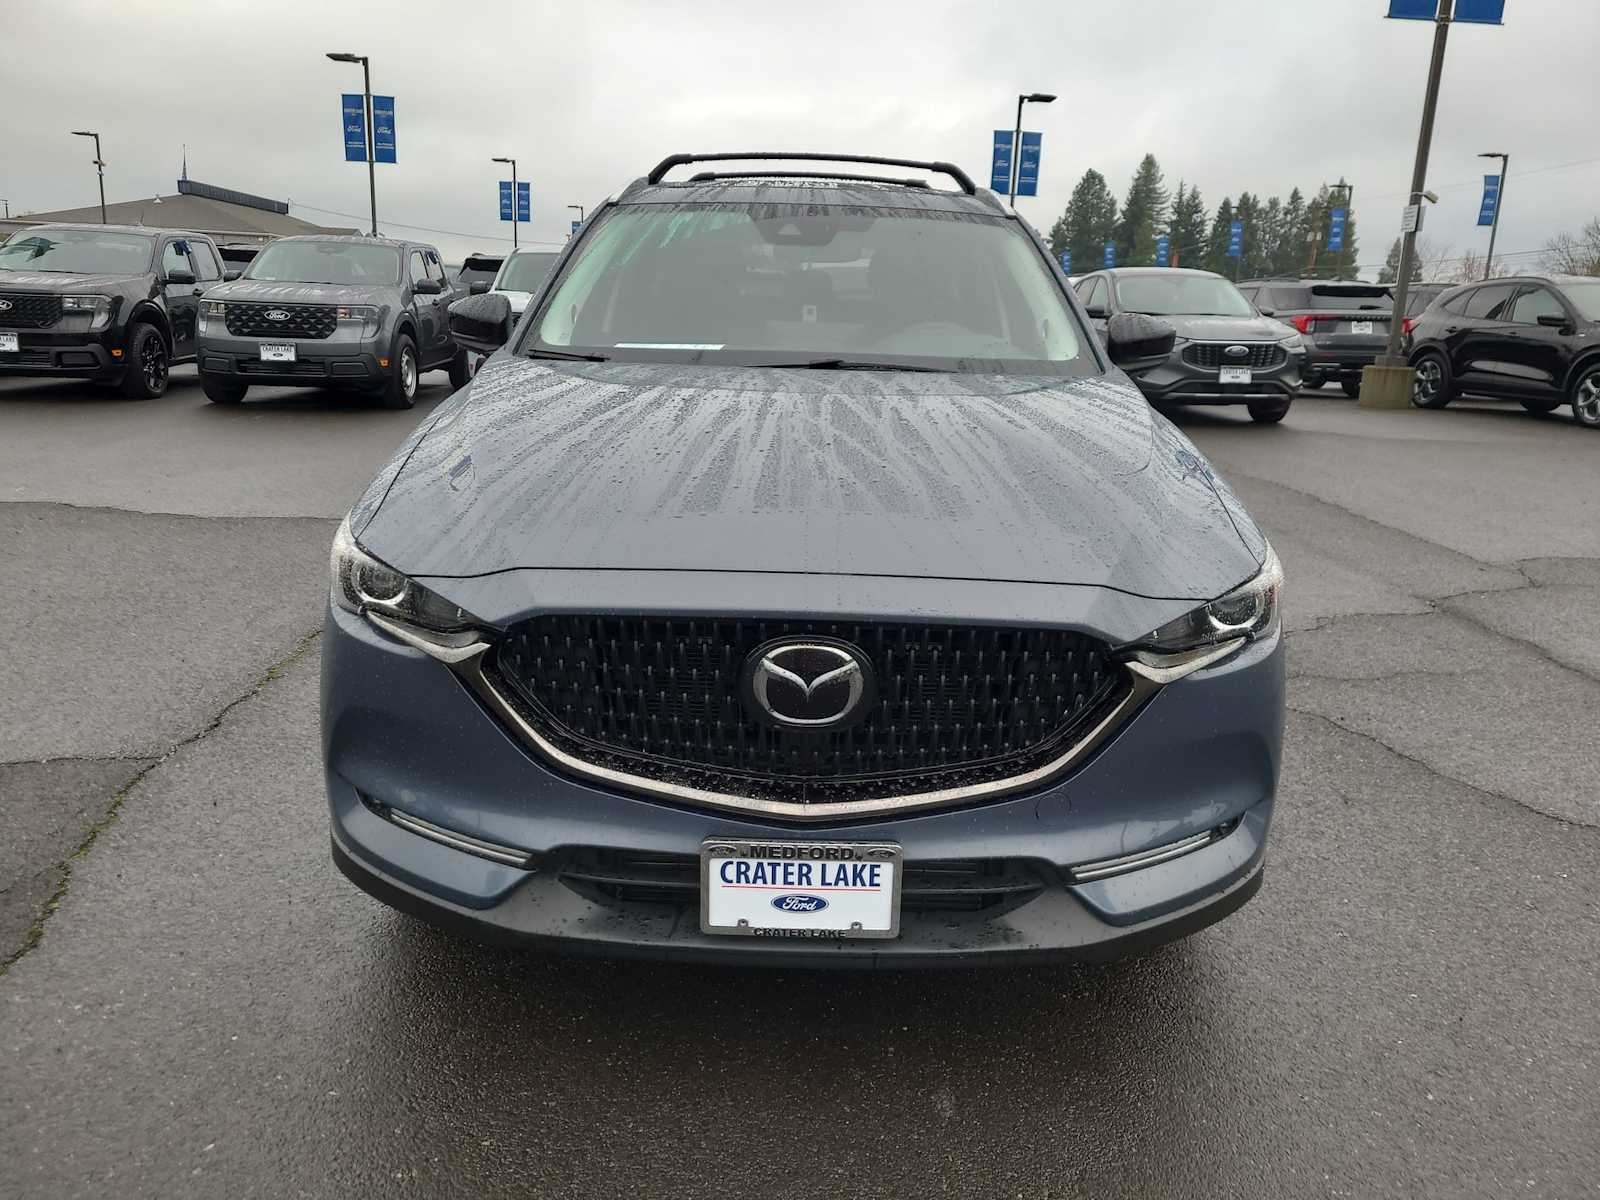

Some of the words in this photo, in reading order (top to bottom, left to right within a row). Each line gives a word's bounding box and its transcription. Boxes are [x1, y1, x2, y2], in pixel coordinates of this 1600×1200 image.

[750, 845, 854, 860] MEDFORD
[720, 861, 812, 886] CRATER
[820, 863, 881, 887] LAKE
[782, 895, 817, 912] Ford
[753, 927, 807, 938] CRATER
[811, 929, 847, 938] LAKE
